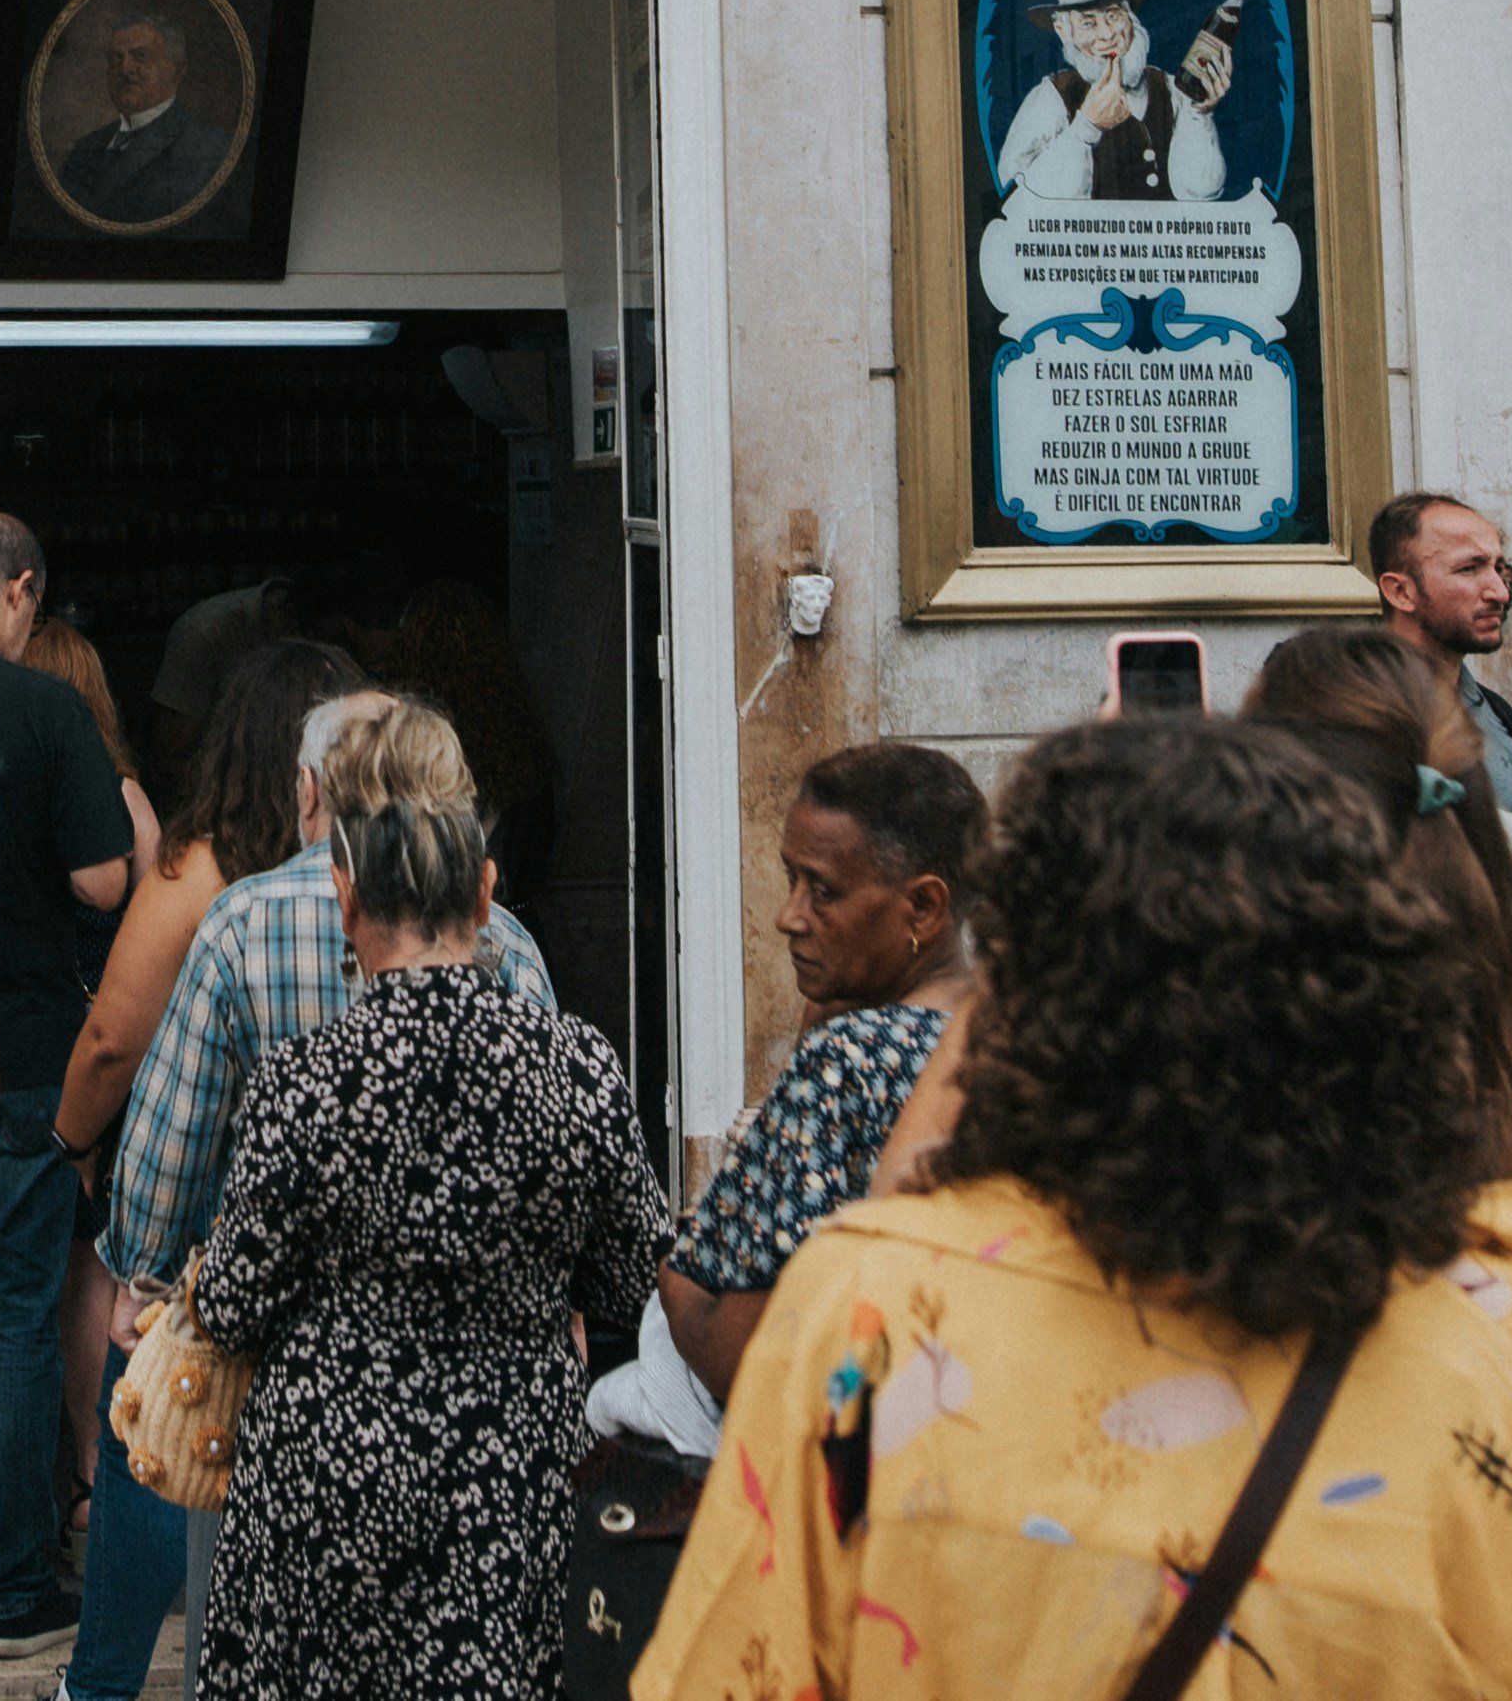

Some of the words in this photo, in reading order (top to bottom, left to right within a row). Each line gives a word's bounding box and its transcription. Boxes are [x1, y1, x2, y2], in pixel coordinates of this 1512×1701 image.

[1028, 219, 1061, 233] LICOR
[1063, 218, 1126, 234] PRODUZIDO
[1128, 220, 1153, 234] COM
[1156, 220, 1163, 235] O
[1166, 217, 1214, 235] PRÓPRIO
[1216, 221, 1251, 236] FRUTO
[1015, 243, 1072, 258] PREMIADA
[1074, 243, 1100, 258] COM
[1102, 244, 1117, 258] AS
[1120, 244, 1148, 259] MAIS
[1151, 244, 1183, 259] ALTAS
[1186, 245, 1266, 260] RECOMPENSAS
[1023, 267, 1046, 282] NAS
[1048, 265, 1117, 285] EXPOSIÇÕES
[1119, 268, 1136, 283] EM
[1138, 268, 1160, 284] QUE
[1162, 269, 1186, 284] TEM
[1188, 269, 1259, 284] PARTICIPADO
[1035, 358, 1043, 380] É
[1049, 362, 1089, 380] MAIS
[1094, 358, 1134, 381] FÁCIL
[1140, 362, 1174, 381] COM
[1179, 363, 1214, 381] UMA
[1219, 358, 1253, 381] MÃO
[1052, 388, 1080, 406] DEZ
[1085, 388, 1162, 407] ESTRELAS
[1167, 389, 1238, 407] AGARRAR
[1064, 414, 1110, 433] FAZER
[1115, 415, 1125, 433] O
[1130, 415, 1158, 433] SOL
[1164, 415, 1227, 433] ESFRIAR
[1041, 441, 1106, 459] REDUZIR
[1111, 441, 1121, 459] O
[1126, 441, 1182, 460] MUNDO
[1187, 441, 1197, 459] A
[1202, 441, 1251, 460] GRUDE
[1034, 467, 1069, 486] MAS
[1074, 467, 1121, 486] GINJA
[1126, 467, 1160, 486] COM
[1165, 467, 1191, 486] TAL
[1196, 467, 1260, 486] VIRTUDE
[1055, 490, 1062, 512] É
[1068, 490, 1122, 512] DIFÍCIL
[1126, 494, 1145, 512] DE
[1150, 494, 1241, 512] ENCONTRAR
